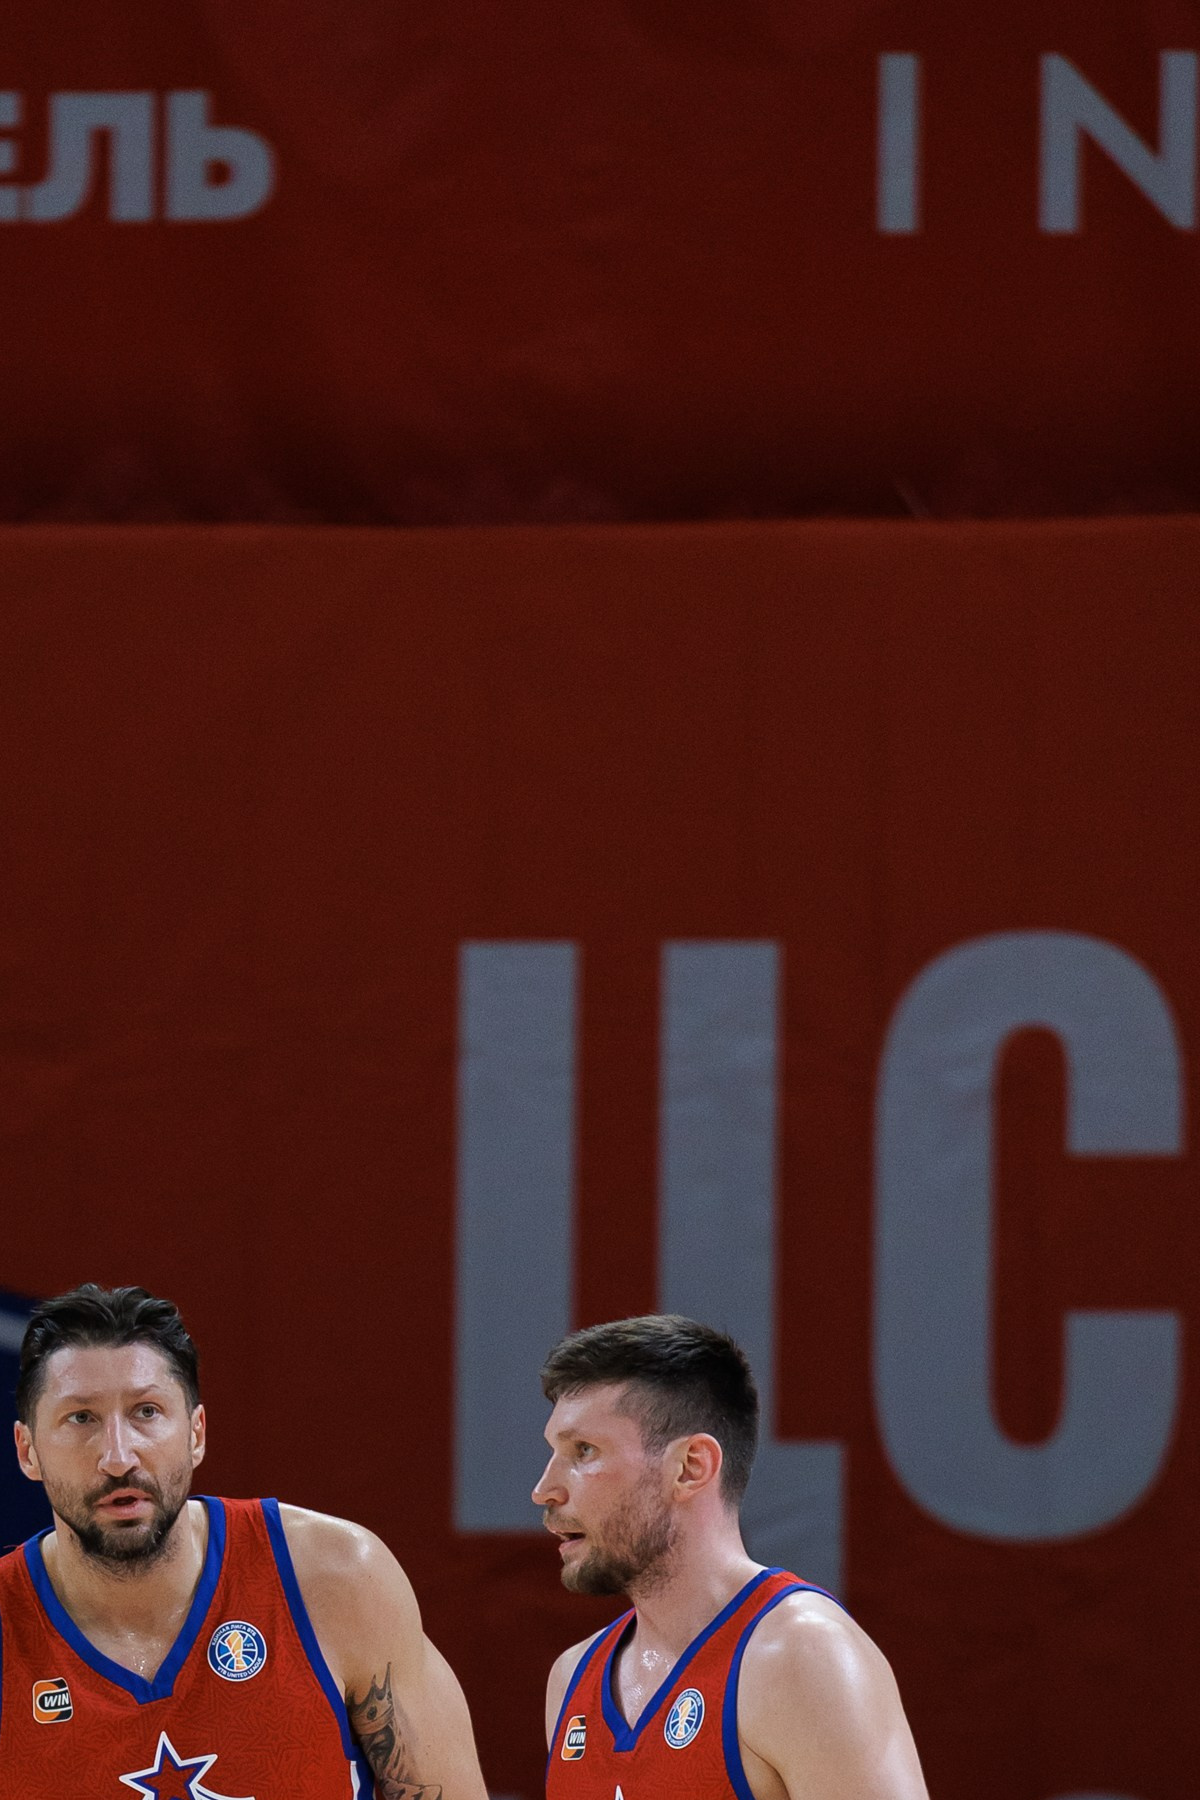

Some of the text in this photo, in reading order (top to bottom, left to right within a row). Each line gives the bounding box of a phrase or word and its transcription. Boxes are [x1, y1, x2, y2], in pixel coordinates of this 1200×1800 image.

[452, 927, 1187, 1600] ЦС
[43, 1692, 70, 1709] WIN
[569, 1731, 586, 1744] WIN
